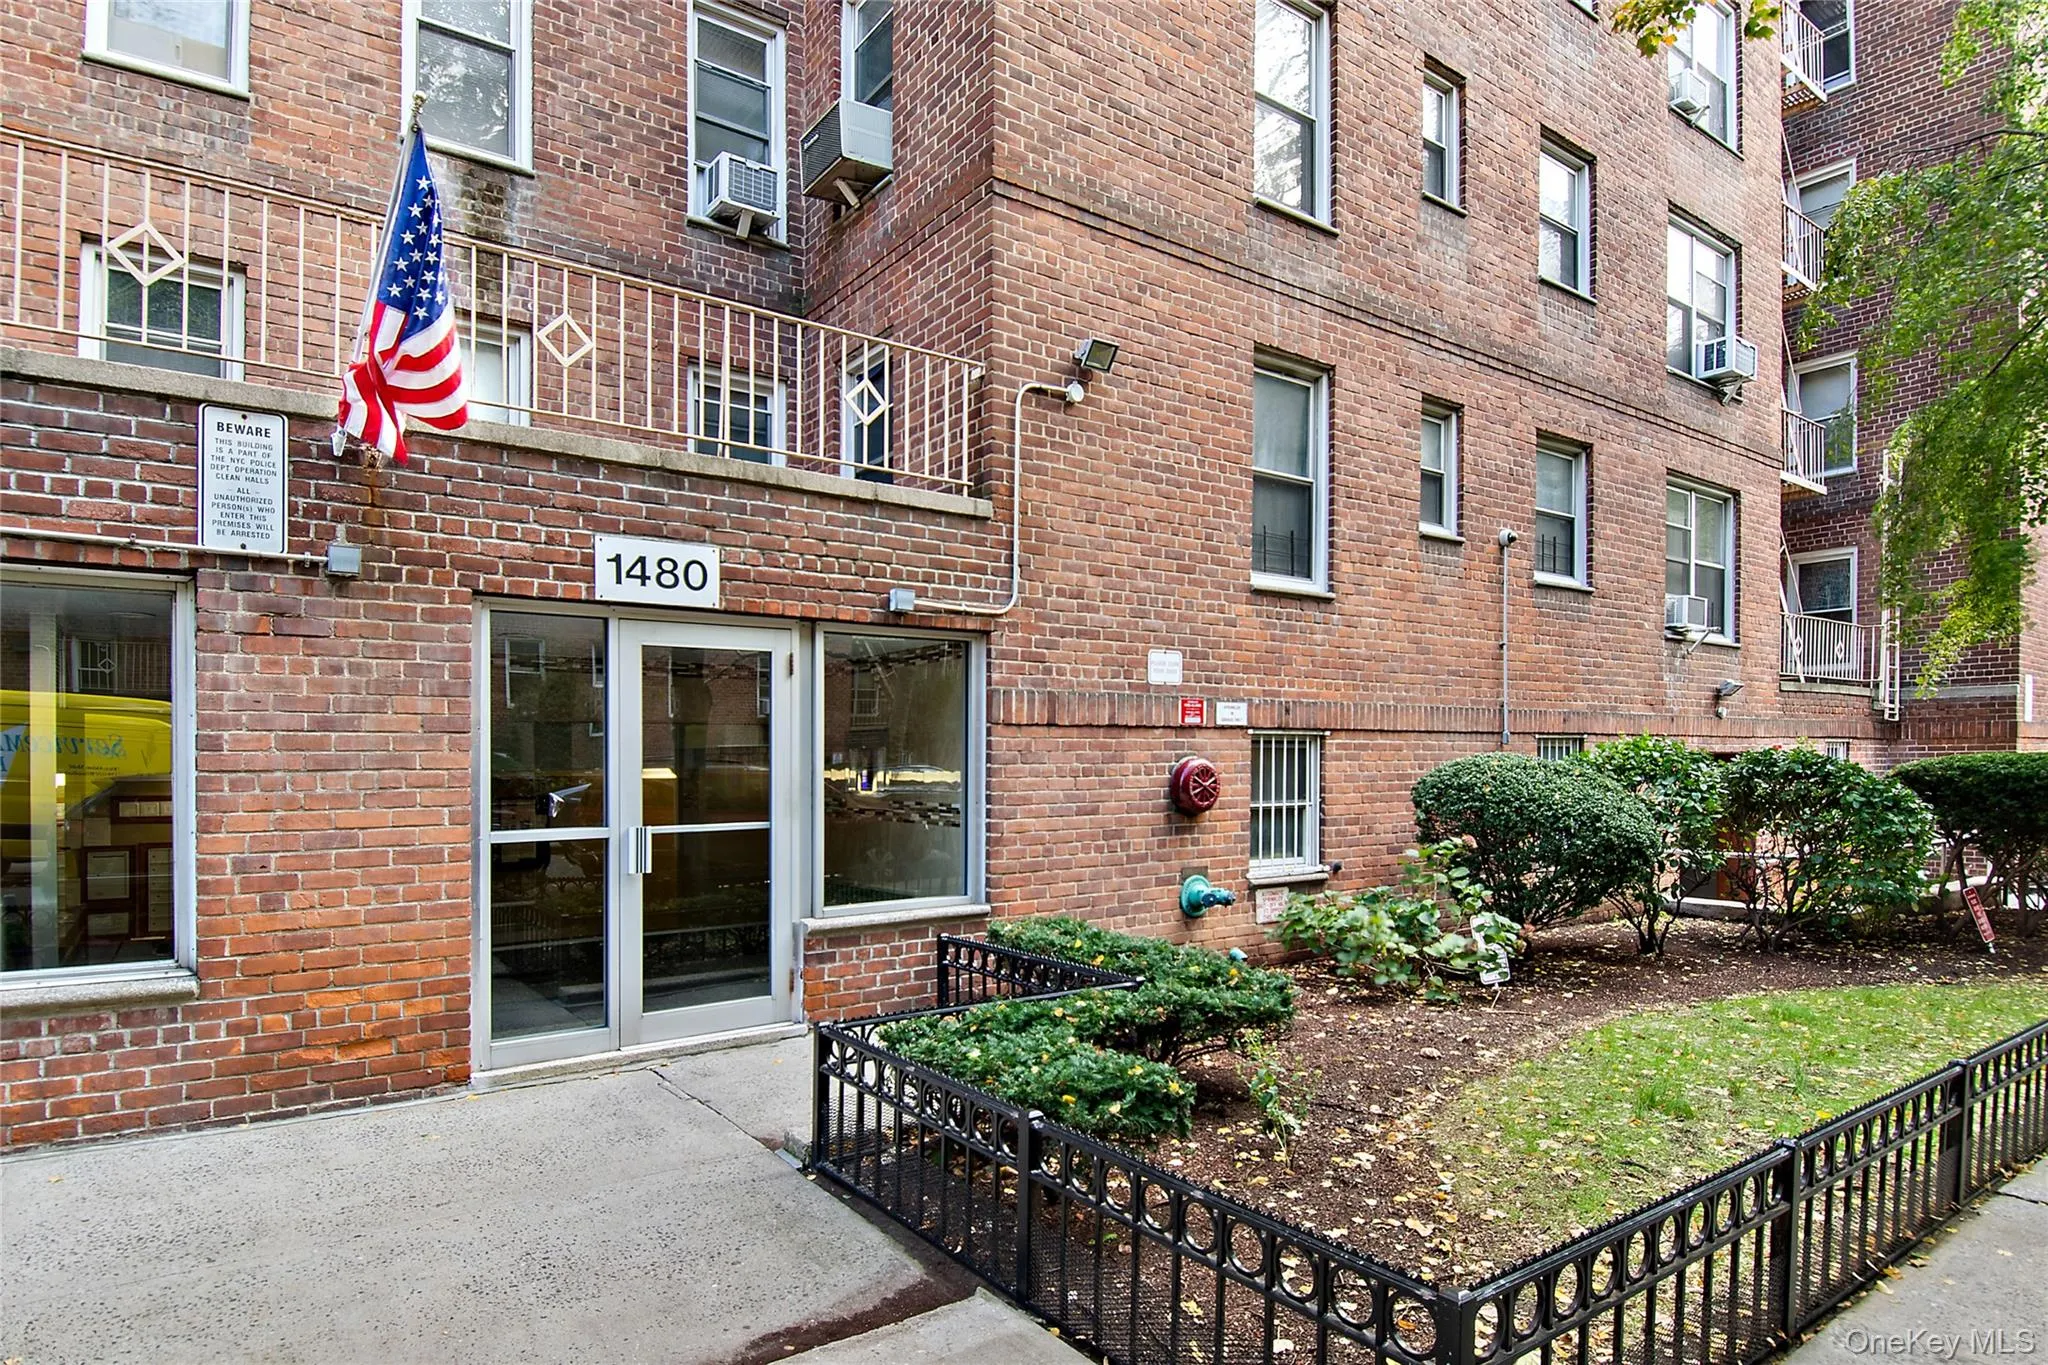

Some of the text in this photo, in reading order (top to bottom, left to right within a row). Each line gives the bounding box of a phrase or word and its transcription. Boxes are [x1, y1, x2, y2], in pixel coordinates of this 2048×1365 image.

[217, 422, 271, 438] BEWARE
[215, 438, 273, 451] THIS BUILDING
[238, 449, 257, 458] PART
[230, 457, 245, 465] NYC
[250, 460, 276, 468] POLICE
[210, 463, 277, 477] DEPT OPERATION
[216, 473, 240, 481] CLEAN
[214, 494, 273, 505] UNAUTHORIZED
[212, 520, 274, 531] PREMISES WILL
[231, 531, 270, 539] ARRESTED
[606, 553, 708, 591] 1480
